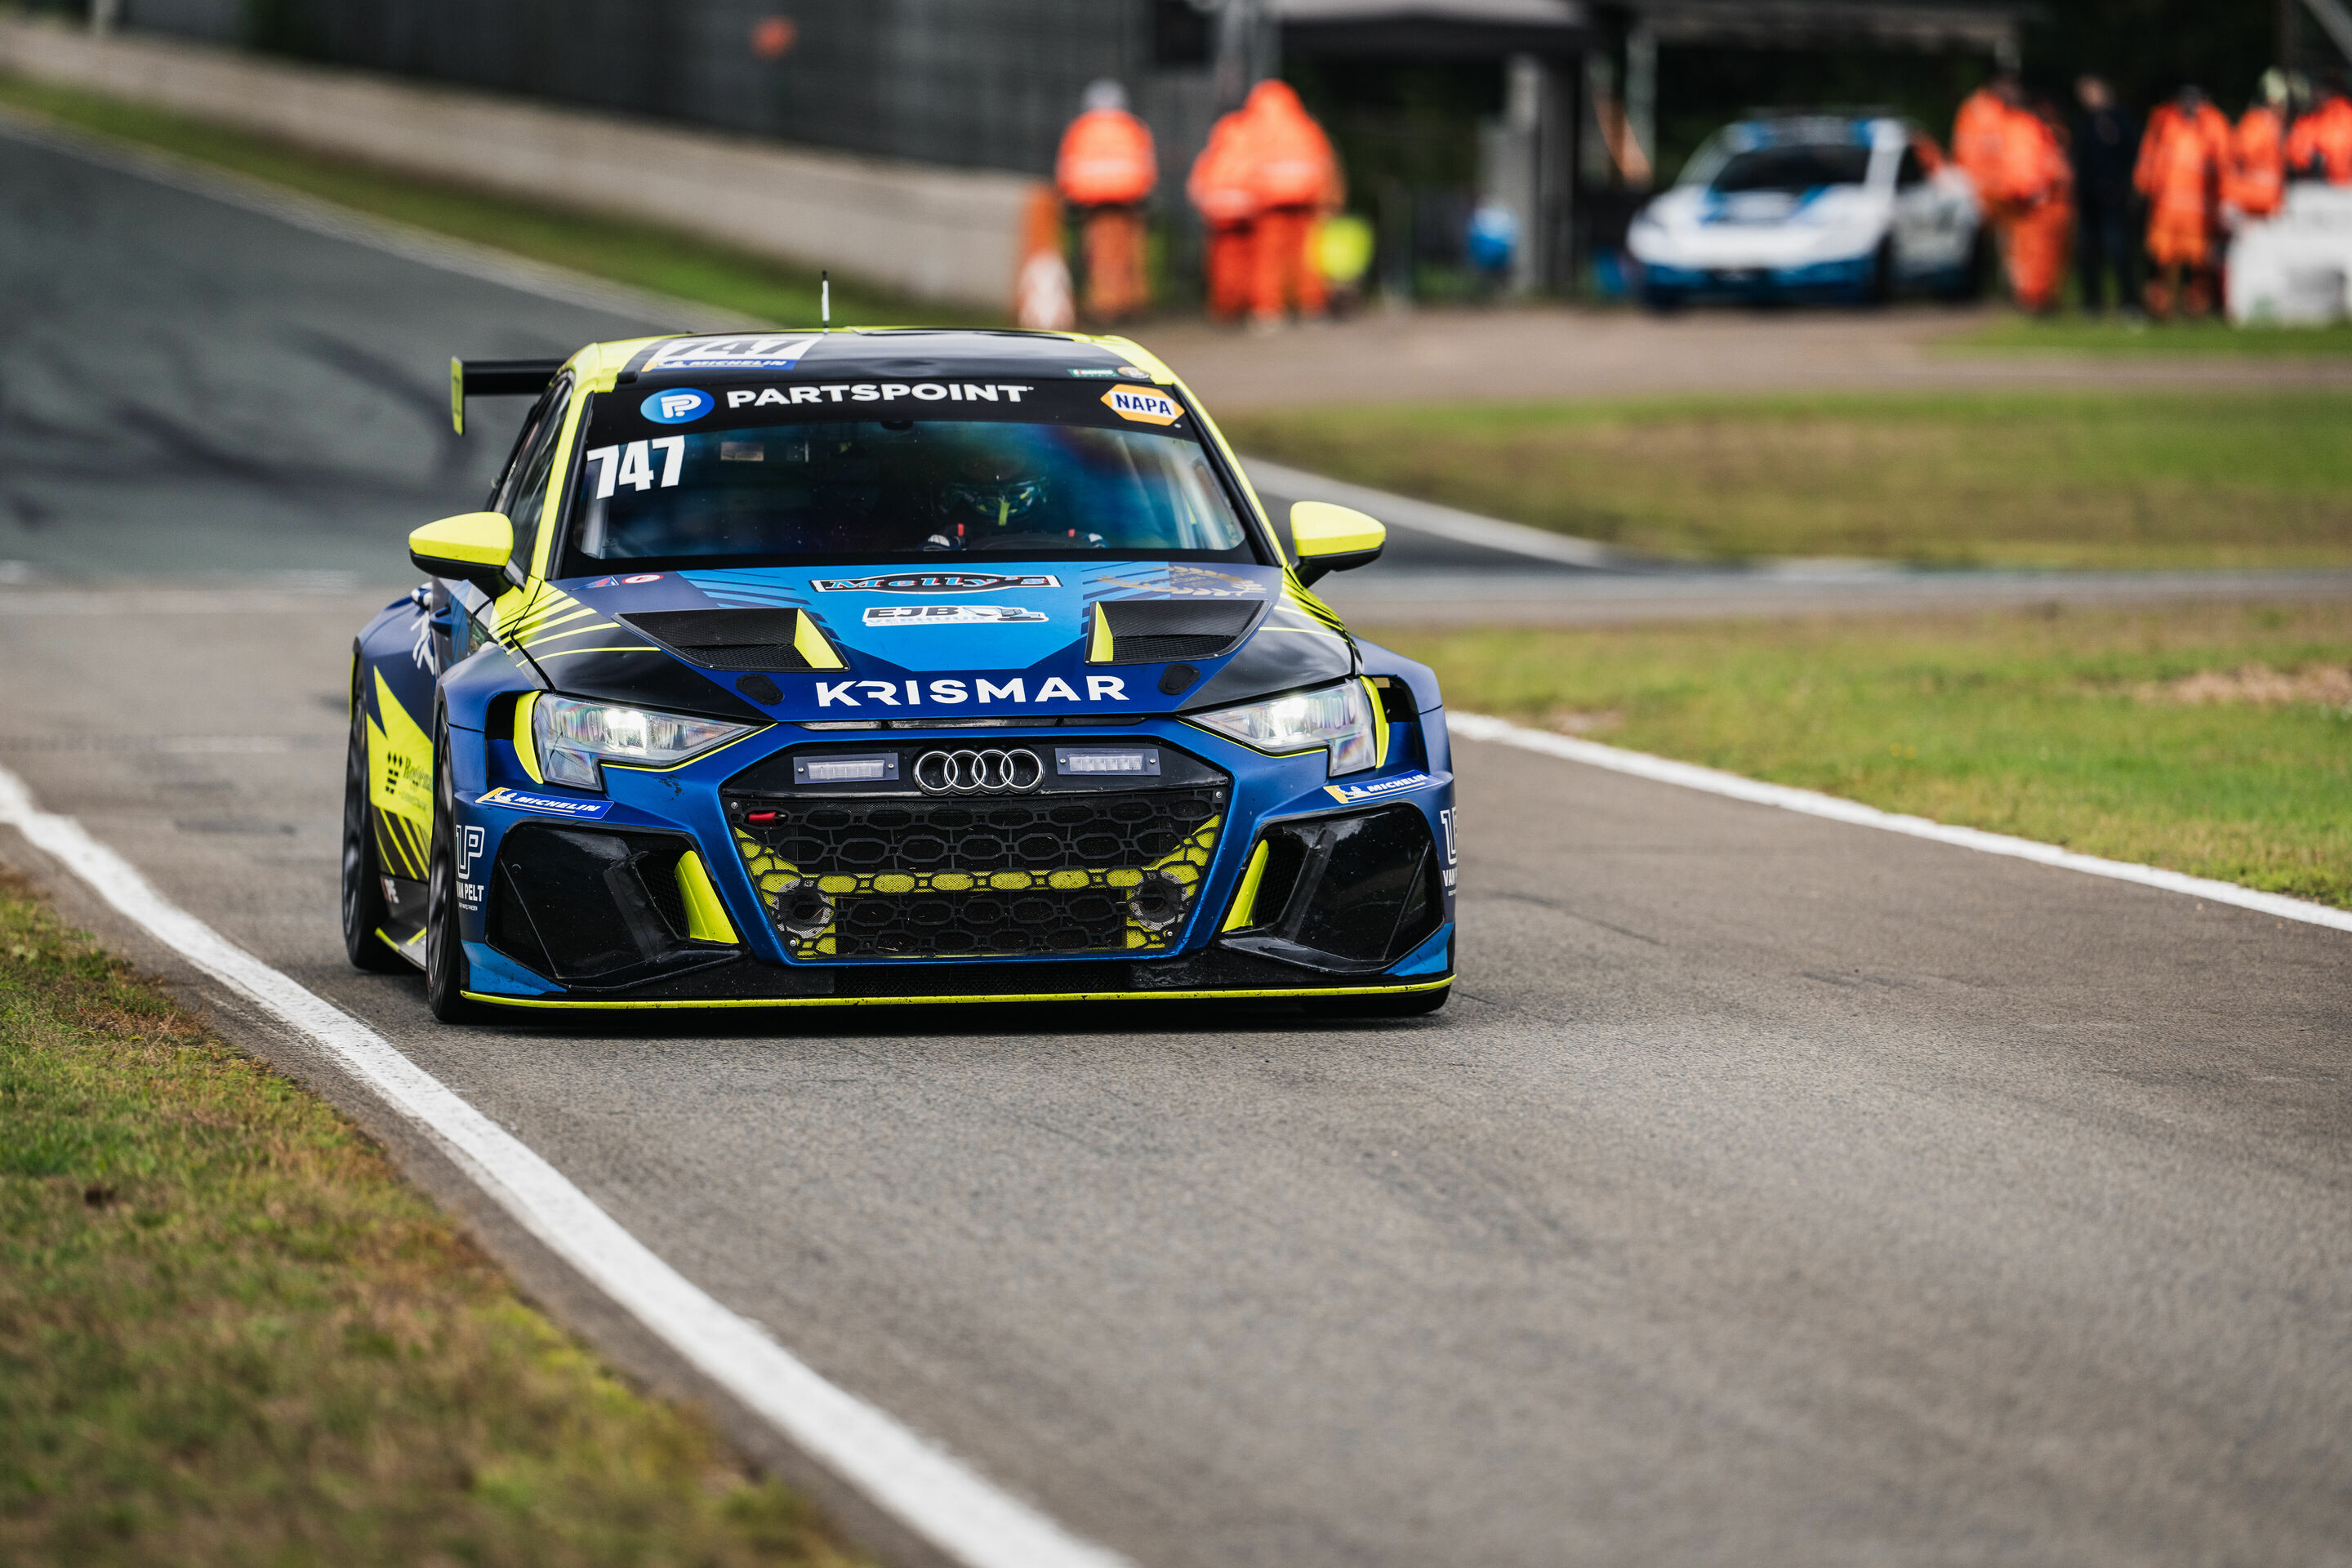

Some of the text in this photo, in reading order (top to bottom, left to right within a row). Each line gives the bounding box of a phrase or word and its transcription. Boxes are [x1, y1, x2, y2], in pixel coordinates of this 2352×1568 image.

[666, 339, 808, 358] 747
[726, 384, 1028, 408] PARTSPOINT
[1115, 394, 1172, 415] NAPA
[586, 434, 685, 499] 747
[867, 607, 960, 618] EJB
[815, 675, 1130, 707] KRISMAR
[1367, 773, 1428, 792] MICHELIN
[514, 796, 601, 812] MICHELIN
[465, 883, 484, 902] PELT
